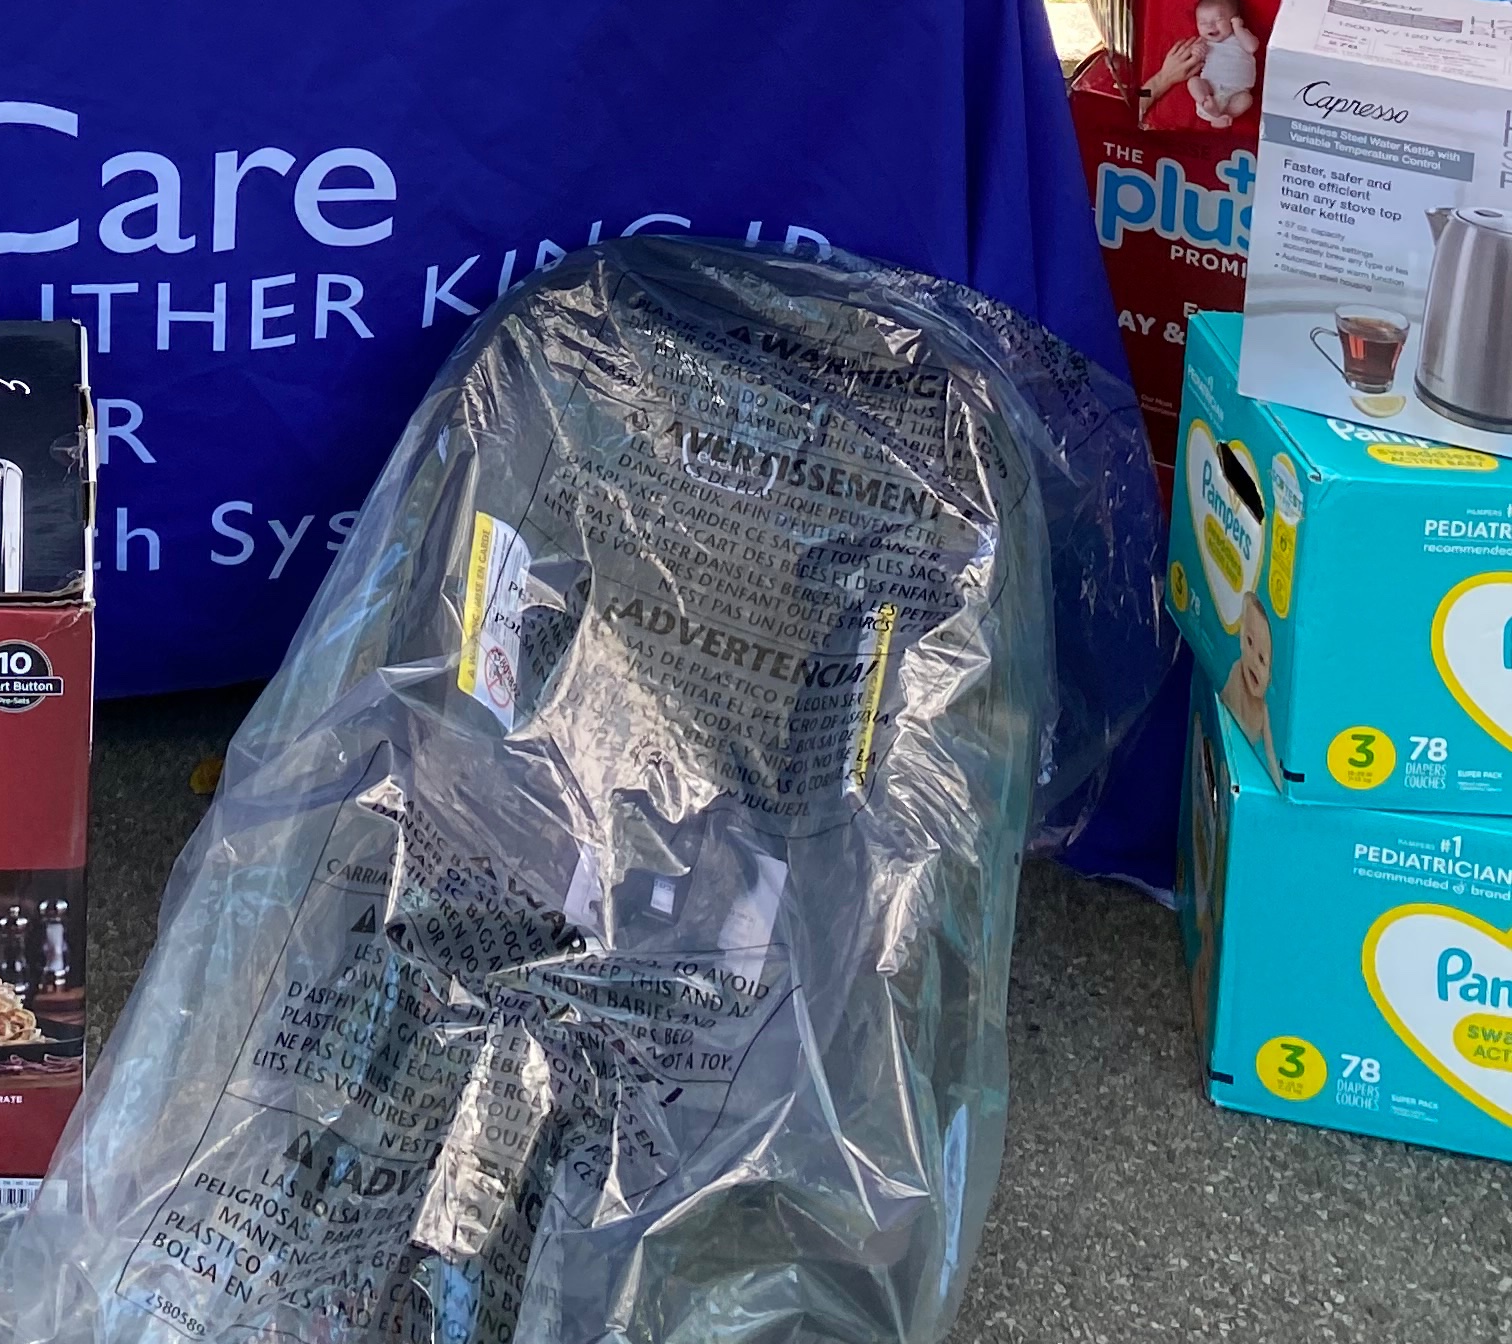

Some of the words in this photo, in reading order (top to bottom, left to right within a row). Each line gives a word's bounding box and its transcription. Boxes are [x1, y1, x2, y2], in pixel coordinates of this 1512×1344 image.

[1293, 80, 1409, 124] Capresso
[1103, 142, 1144, 164] THE
[1289, 132, 1331, 149] Variable
[1334, 140, 1400, 163] Temperature
[1402, 155, 1441, 170] Control
[1290, 121, 1338, 139] Stainless
[1340, 131, 1368, 145] Steel
[1369, 137, 1400, 151] Water
[1404, 143, 1435, 158] Kettle
[1437, 150, 1461, 162] with
[1282, 174, 1315, 189] more
[1318, 182, 1371, 201] efficient
[1283, 158, 1326, 179] Faster,
[1330, 170, 1364, 185] safer
[1366, 179, 1392, 192] and
[1279, 201, 1316, 216] water
[1319, 208, 1356, 225] kettle
[1281, 186, 1309, 202] than
[1313, 194, 1337, 209] any
[1340, 198, 1376, 216] stove
[1380, 207, 1402, 222] top
[1291, 233, 1340, 251] temperature
[1342, 244, 1374, 259] settings
[1202, 458, 1252, 561] Pampers
[20, 679, 54, 693] Button
[1348, 734, 1376, 768] 3
[1409, 736, 1448, 761] 78
[1404, 776, 1446, 790] COUCHES
[1405, 763, 1447, 776] DIAPERS
[1440, 836, 1463, 858] #1
[1354, 843, 1512, 886] PEDIATRICIAN
[1353, 866, 1448, 891] recommended
[1470, 885, 1511, 901] brand
[1278, 1043, 1306, 1079] 3
[1340, 1054, 1381, 1083] 78
[1336, 1092, 1379, 1112] COUCHES
[1337, 1080, 1380, 1100] DIAPERS
